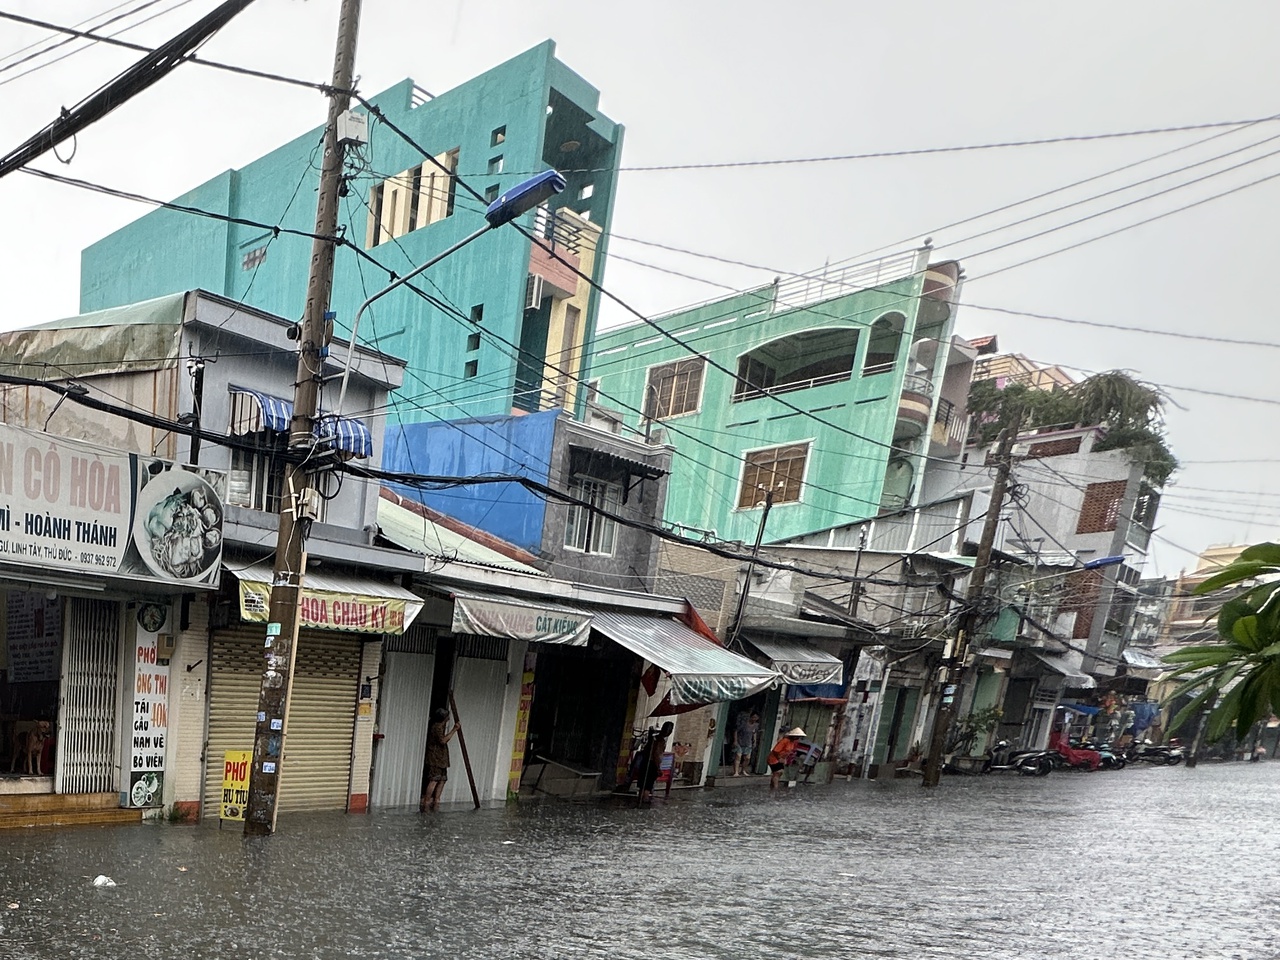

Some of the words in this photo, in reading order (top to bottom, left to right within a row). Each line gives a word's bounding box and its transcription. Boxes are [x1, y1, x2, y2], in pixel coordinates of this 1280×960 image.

[24, 442, 61, 503] CÔ
[70, 454, 120, 514] HÒA
[24, 511, 71, 541] HOÀNH
[75, 520, 117, 547] THÁNH
[11, 543, 27, 556] LINH
[44, 544, 57, 559] THỦ
[58, 546, 72, 561] ĐỨC
[80, 552, 94, 563] 0937
[95, 554, 105, 565] 962
[106, 556, 117, 567] 972
[300, 597, 329, 624] HOA
[332, 598, 367, 627] CHÂU
[137, 641, 157, 664] PHỞ
[136, 667, 152, 694] ÔNG
[154, 674, 167, 699] THỊ
[135, 698, 149, 714] TÁI
[133, 736, 151, 752] NẠM
[153, 733, 164, 749] VÈ
[133, 752, 144, 769] BÒ
[145, 753, 164, 768] VIÊN
[224, 753, 248, 782] PHỞ
[223, 783, 234, 804] HỦ
